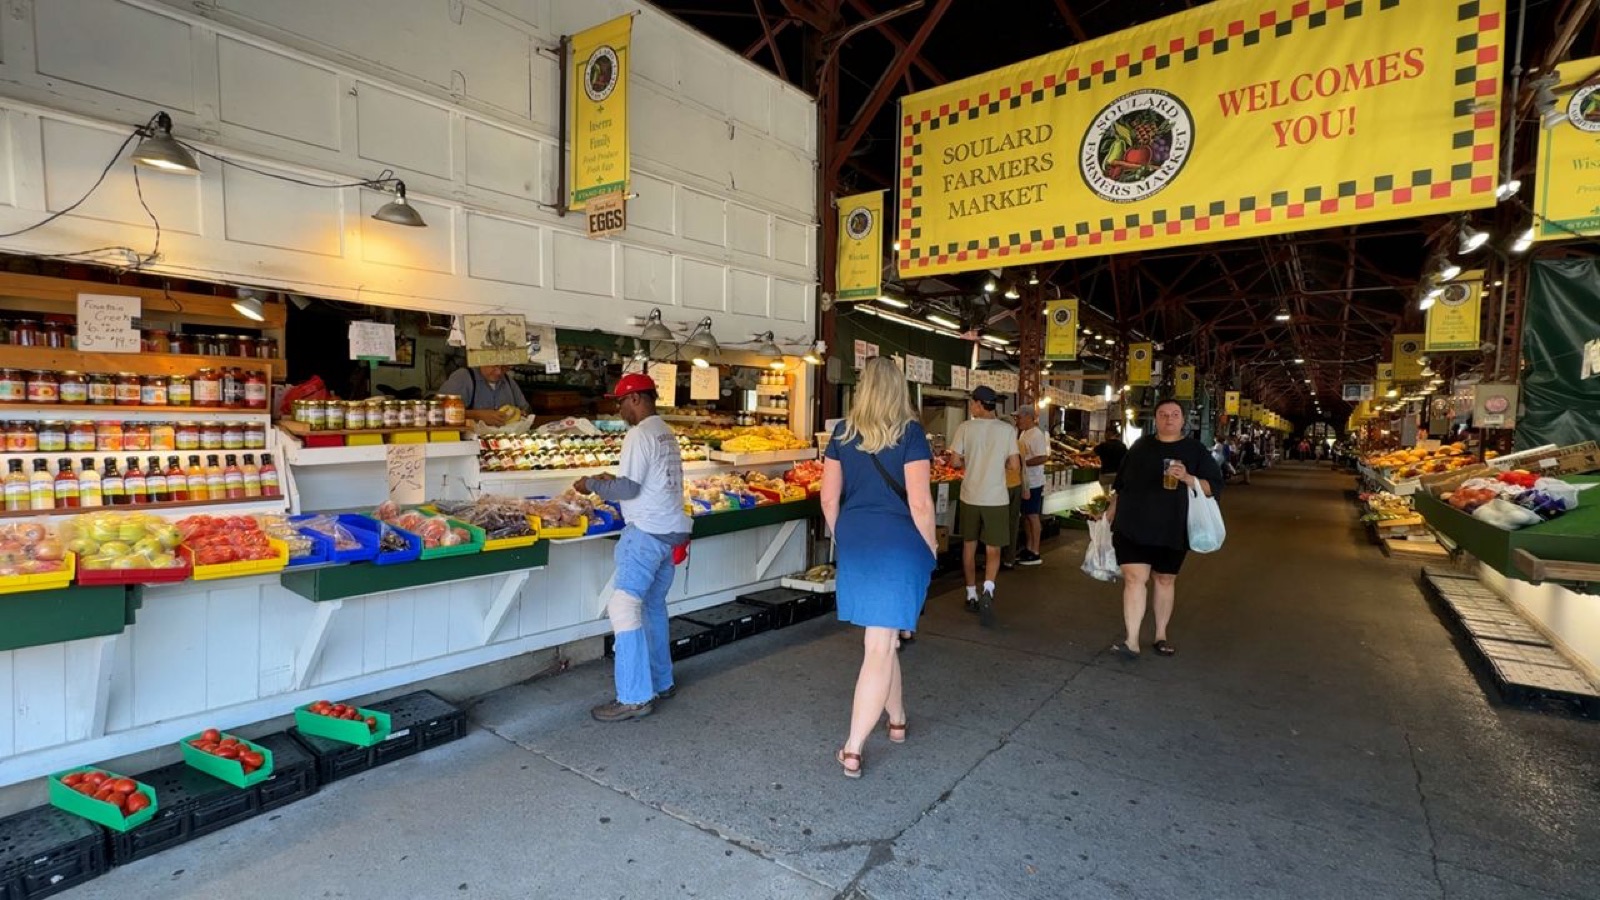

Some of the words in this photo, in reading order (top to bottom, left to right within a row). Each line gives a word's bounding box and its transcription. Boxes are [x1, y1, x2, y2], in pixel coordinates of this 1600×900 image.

[1218, 47, 1425, 118] WELCOMES
[1096, 96, 1179, 136] SOULARD
[1272, 106, 1356, 149] YOU!
[943, 124, 1054, 165] SOULARD
[1085, 141, 1131, 197] FARMERS
[1136, 128, 1187, 193] MARKET
[942, 152, 1054, 193] FARMERS
[589, 209, 623, 233] EGGS
[948, 183, 1048, 220] MARKET
